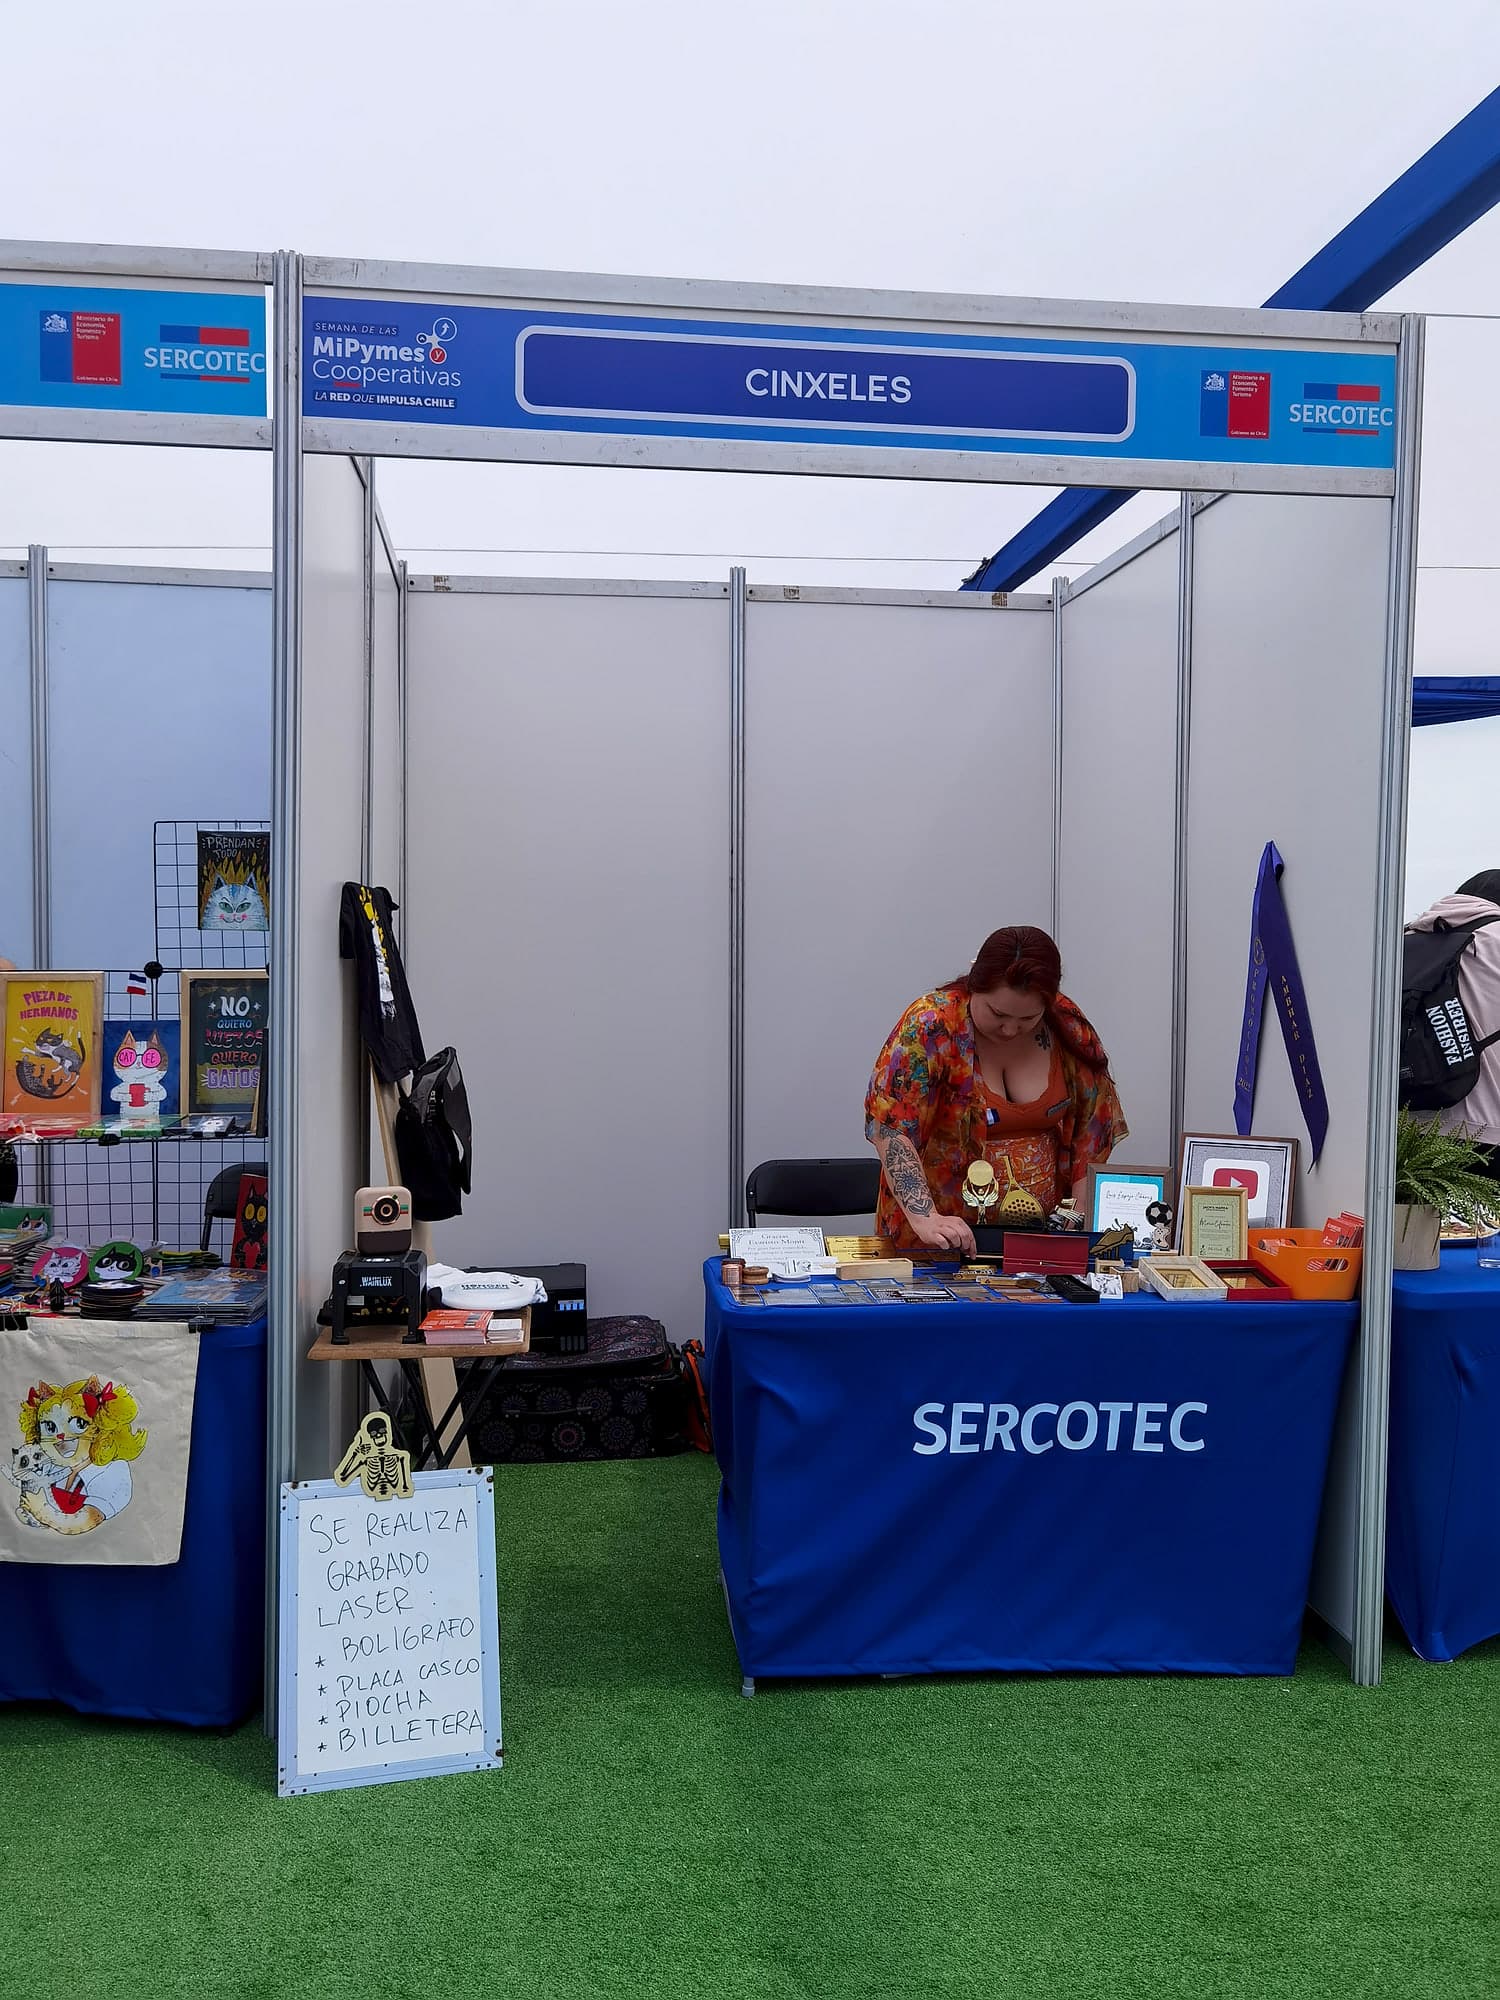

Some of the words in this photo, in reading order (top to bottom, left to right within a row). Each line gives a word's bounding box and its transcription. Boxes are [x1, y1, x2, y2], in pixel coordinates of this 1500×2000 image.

[315, 322, 357, 333] SEMANA
[361, 325, 375, 334] DE
[379, 327, 397, 336] LAS
[144, 347, 266, 373] SERCOTEC
[312, 335, 425, 364] MiPymes
[434, 349, 442, 360] y
[312, 358, 461, 388] Cooperativas
[745, 368, 912, 404] CINXELES
[314, 391, 327, 401] LA
[329, 391, 351, 402] RED
[352, 393, 375, 403] QUE
[376, 394, 423, 407] IMPULSA
[424, 397, 455, 408] CHILE
[1289, 403, 1393, 427] SERCOTEC
[205, 836, 256, 849] PRENDAN
[212, 848, 238, 862] TODO
[23, 990, 56, 1007] PIEZA
[57, 991, 72, 1004] DE
[220, 996, 250, 1017] NO
[19, 1006, 79, 1021] HERMANOS
[217, 1019, 253, 1029] QUIERO
[1425, 1005, 1463, 1066] FASHION
[211, 1051, 257, 1066] QUIERO
[206, 1067, 261, 1090] GATOS
[912, 1400, 1208, 1455] SERCOTEC
[309, 1514, 350, 1554] SE
[366, 1508, 469, 1546] REALIZA
[327, 1551, 429, 1592] GRABADO
[341, 1616, 475, 1663] BOLIGRAFO
[336, 1669, 404, 1697] PLACA
[419, 1658, 480, 1681] CASCO
[335, 1689, 433, 1723] PIOCHA
[338, 1709, 483, 1753] BILLETERA
